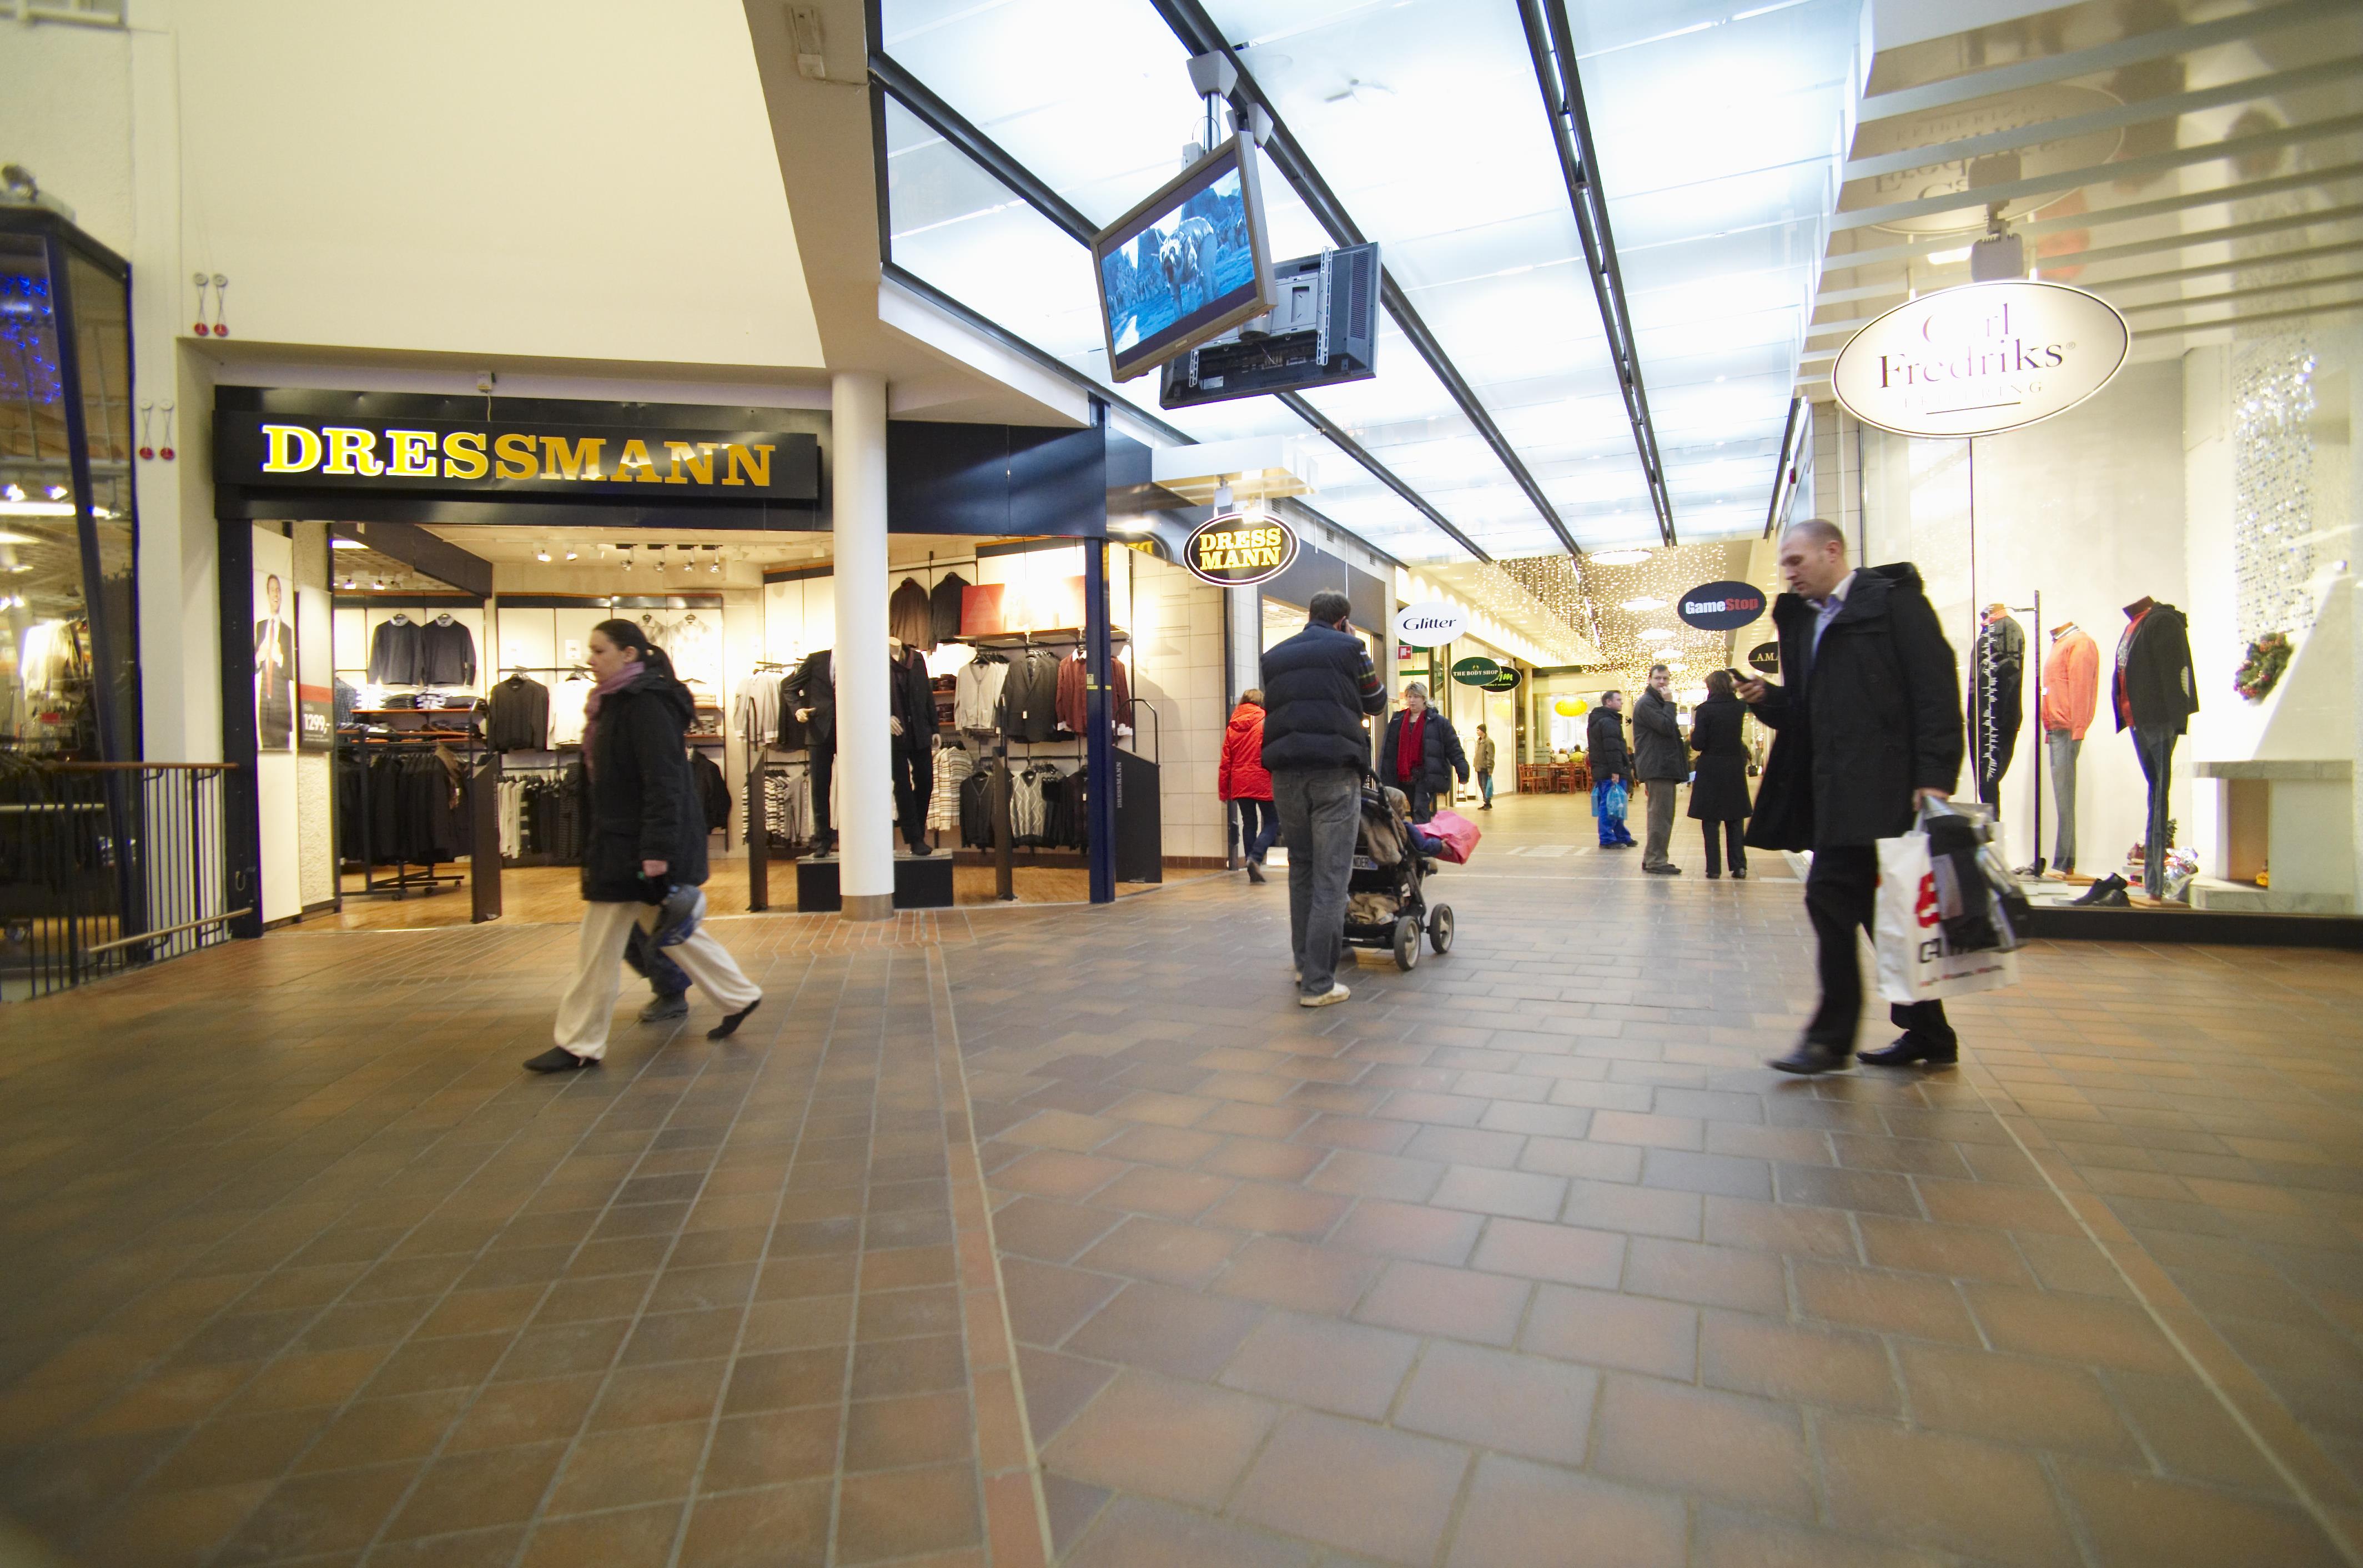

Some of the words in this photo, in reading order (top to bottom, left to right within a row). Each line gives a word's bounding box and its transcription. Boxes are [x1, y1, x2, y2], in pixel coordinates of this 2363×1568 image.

[1877, 338, 2064, 389] Fredriks
[261, 424, 776, 487] DRESSMANN
[1199, 527, 1281, 552] DRESS
[1199, 546, 1281, 571] MANN
[1685, 597, 1759, 615] GameStop
[1403, 617, 1456, 631] Glitter
[1757, 652, 1778, 661] AM
